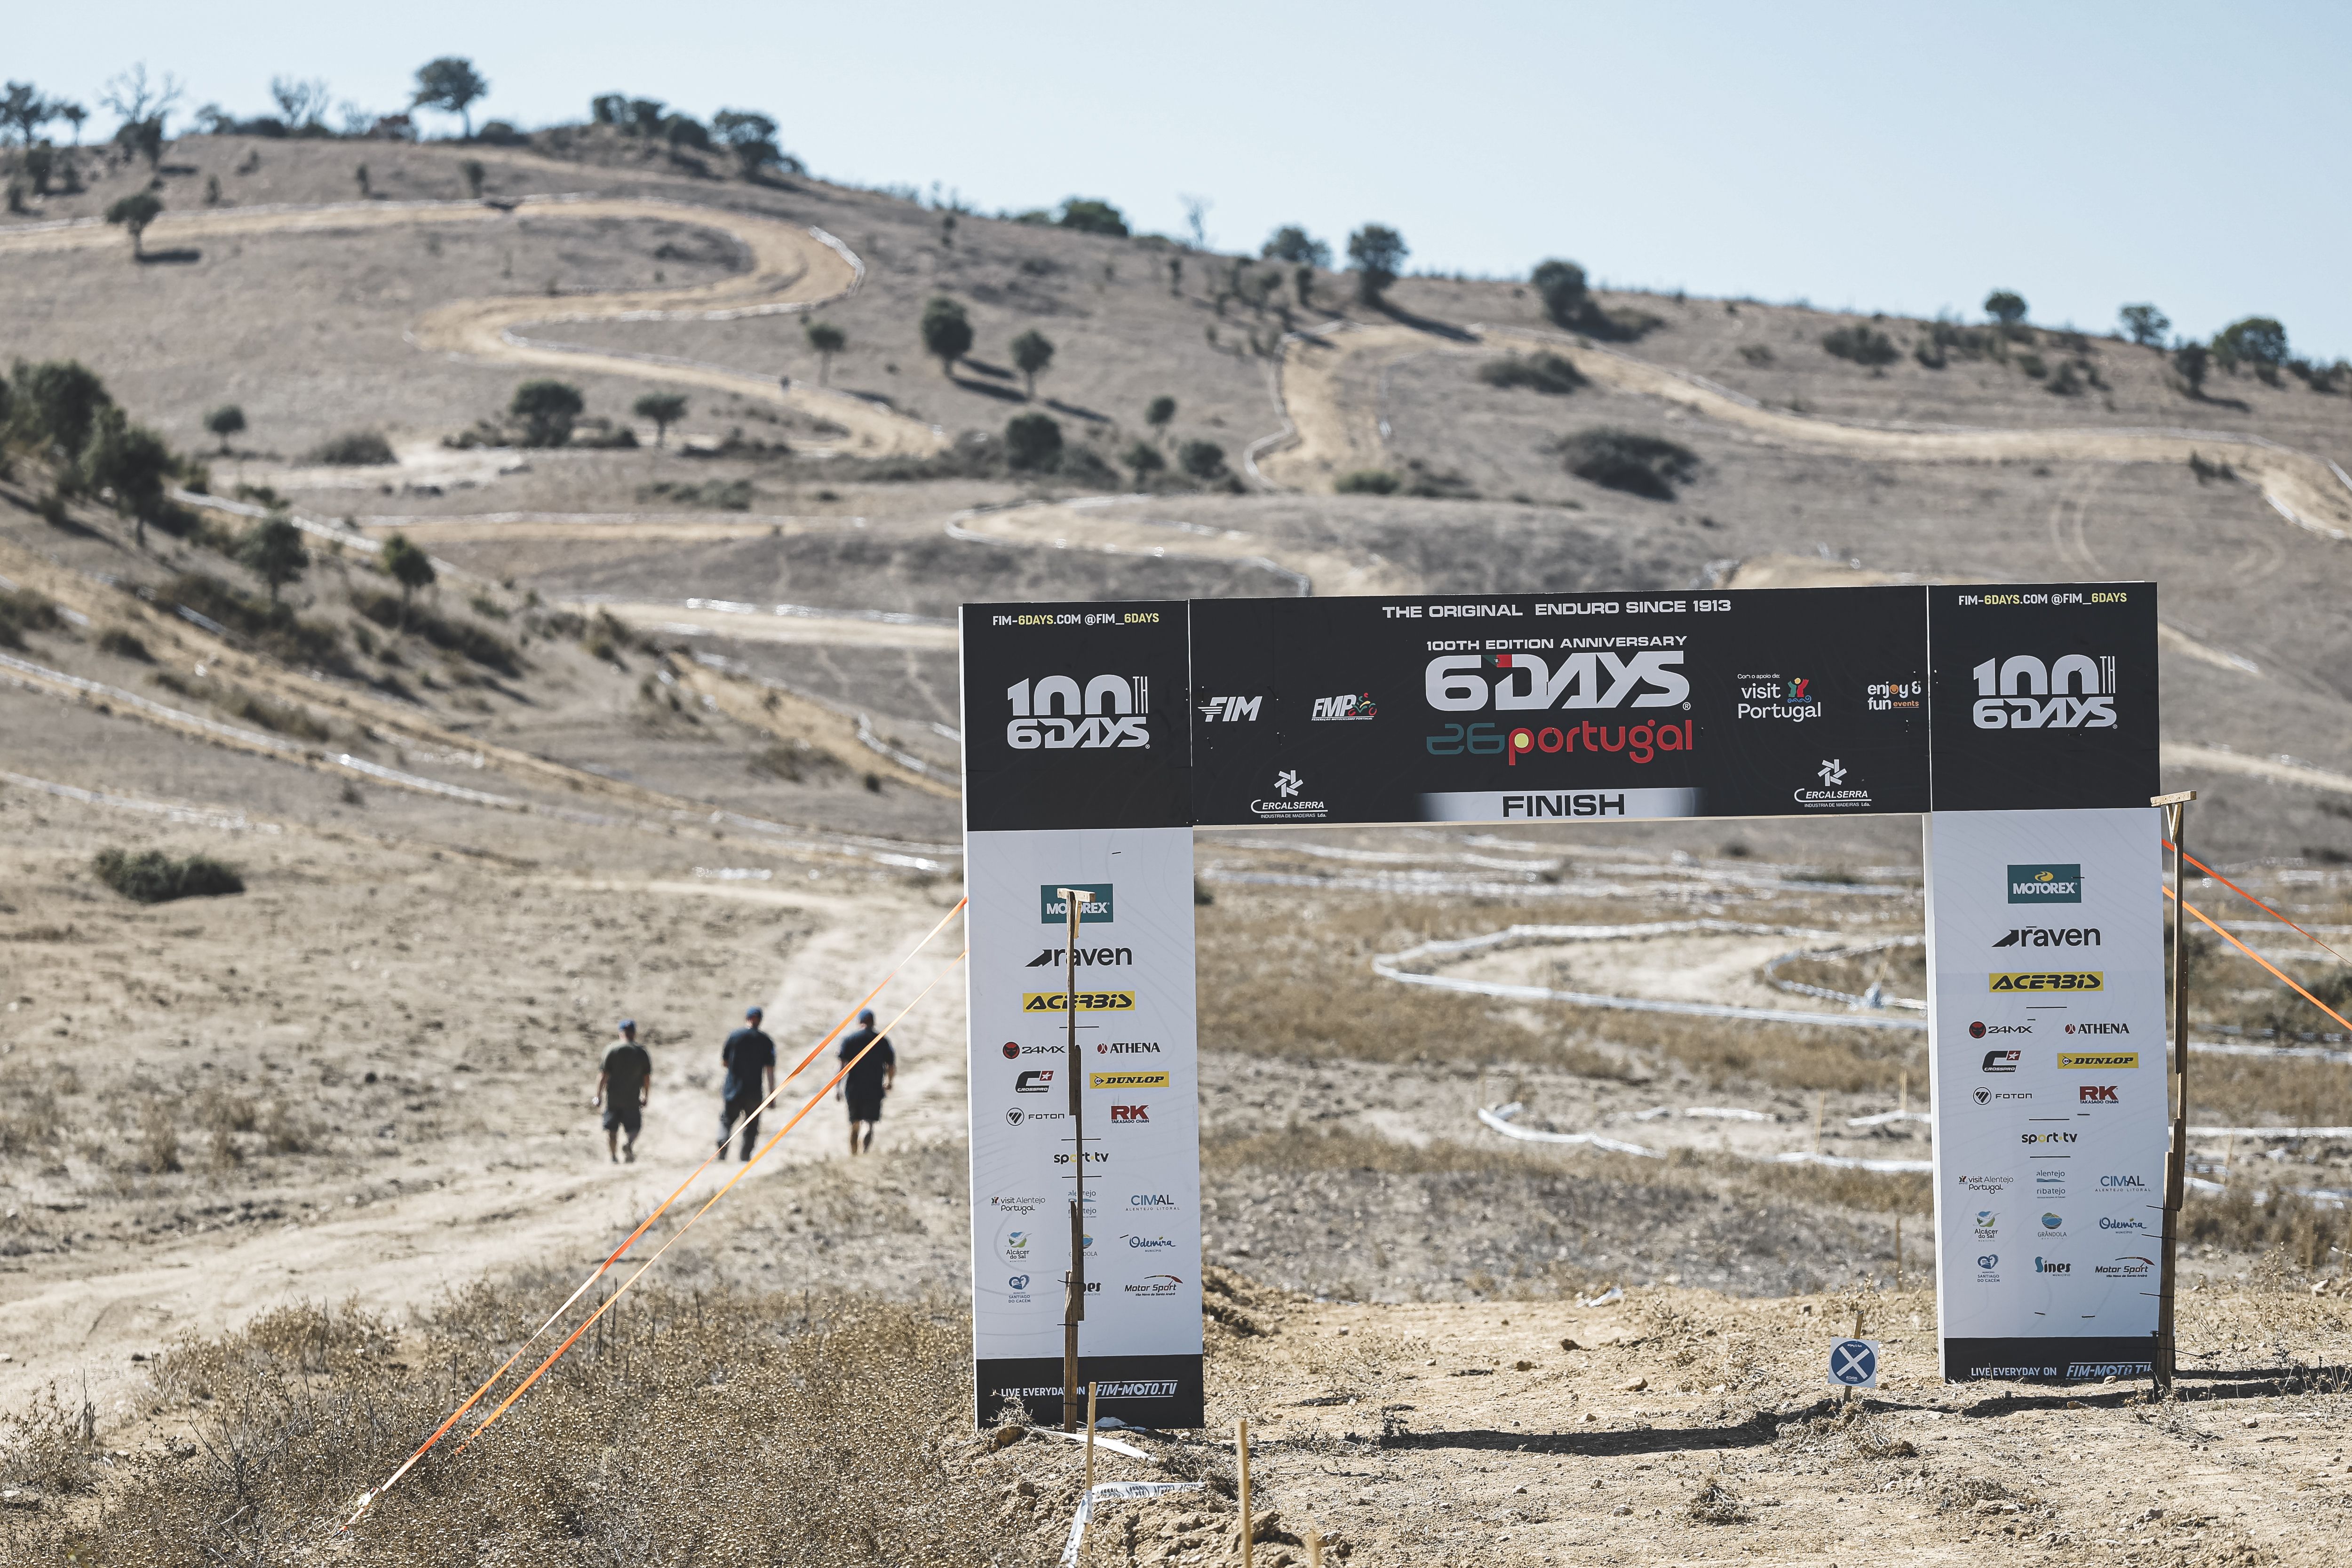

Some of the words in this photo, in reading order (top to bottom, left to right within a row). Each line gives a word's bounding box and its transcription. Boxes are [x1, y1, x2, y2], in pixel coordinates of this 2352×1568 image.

[1959, 594, 2048, 605] FIM-6DAYS.COM
[2051, 593, 2127, 605] @FIM_6DAYS
[1383, 606, 1422, 618] THE
[1429, 605, 1523, 617] ORIGINAL
[1535, 602, 1619, 615] ENDURO
[1626, 600, 1686, 613] SINCE
[1693, 599, 1731, 612] 1913
[993, 614, 1081, 626] FIM-6DAYS.COM
[1085, 613, 1159, 626] @FIM_6DAYS
[1427, 640, 1479, 651] 100TH
[1486, 638, 1553, 650] EDITION
[1560, 636, 1687, 649] ANNIVERSARY
[1741, 683, 1781, 699] visit
[1867, 682, 1908, 698] enjoy
[1197, 696, 1263, 722] FIM
[1312, 694, 1357, 717] FMP
[1867, 697, 1891, 710] fun
[1738, 702, 1821, 722] Portugal
[1794, 788, 1868, 803] CERCALSERRA
[1251, 799, 1324, 813] CERCALSERRA
[1502, 794, 1625, 818] FINISH
[2013, 883, 2075, 894] MOTOREX
[1047, 902, 1108, 914] MOREX
[2021, 927, 2101, 947] raven
[1992, 974, 2101, 990] ACERBIS
[2078, 1023, 2130, 1034] ATHENA
[1022, 1045, 1065, 1054] 24MX
[1110, 1042, 1161, 1054] ATHENA
[2079, 1086, 2118, 1100] RK
[1111, 1105, 1149, 1120] RK
[2100, 1176, 2145, 1186] CIMAL
[1969, 1184, 2003, 1194] Portugal
[1131, 1194, 1174, 1205] CIMAL
[1001, 1205, 1035, 1215] Portugal
[2099, 1217, 2147, 1229] Odemira
[1129, 1236, 1176, 1248] Odemira
[2035, 1256, 2071, 1273] Sines
[2123, 1266, 2148, 1274] Sport
[1152, 1284, 1176, 1292] Sport
[1971, 1368, 1990, 1376] LIVE
[1993, 1367, 2040, 1376] EVERYDAY
[2043, 1367, 2057, 1376] ON
[1001, 1388, 1020, 1397] LIVE
[1023, 1387, 1065, 1396] EVERYDA
